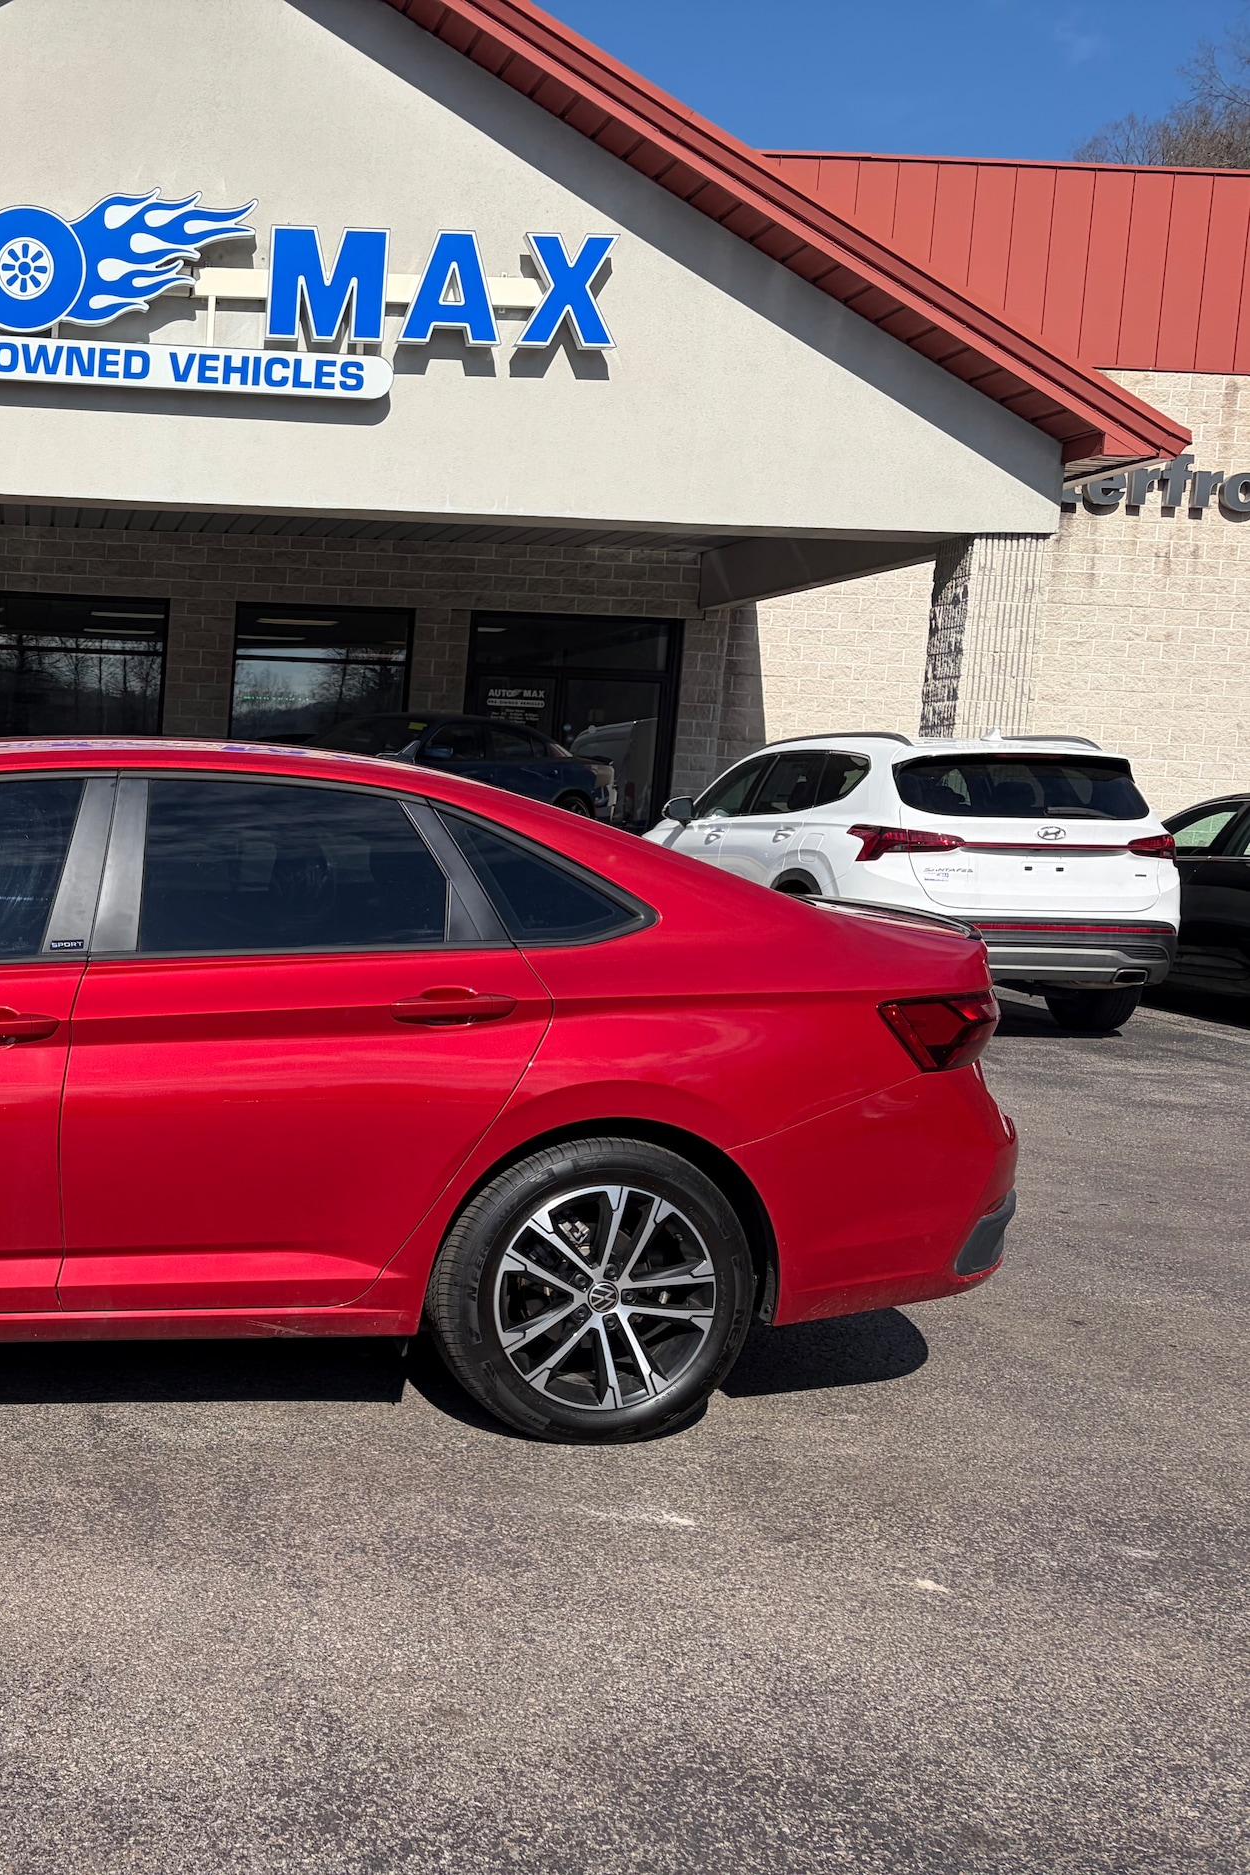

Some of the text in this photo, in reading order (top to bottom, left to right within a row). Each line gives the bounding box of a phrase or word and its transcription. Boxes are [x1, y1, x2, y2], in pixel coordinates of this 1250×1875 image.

[267, 226, 617, 346] MAX
[169, 352, 364, 391] VEHICLES
[1061, 454, 1250, 512] erfro
[522, 689, 545, 699] MAX
